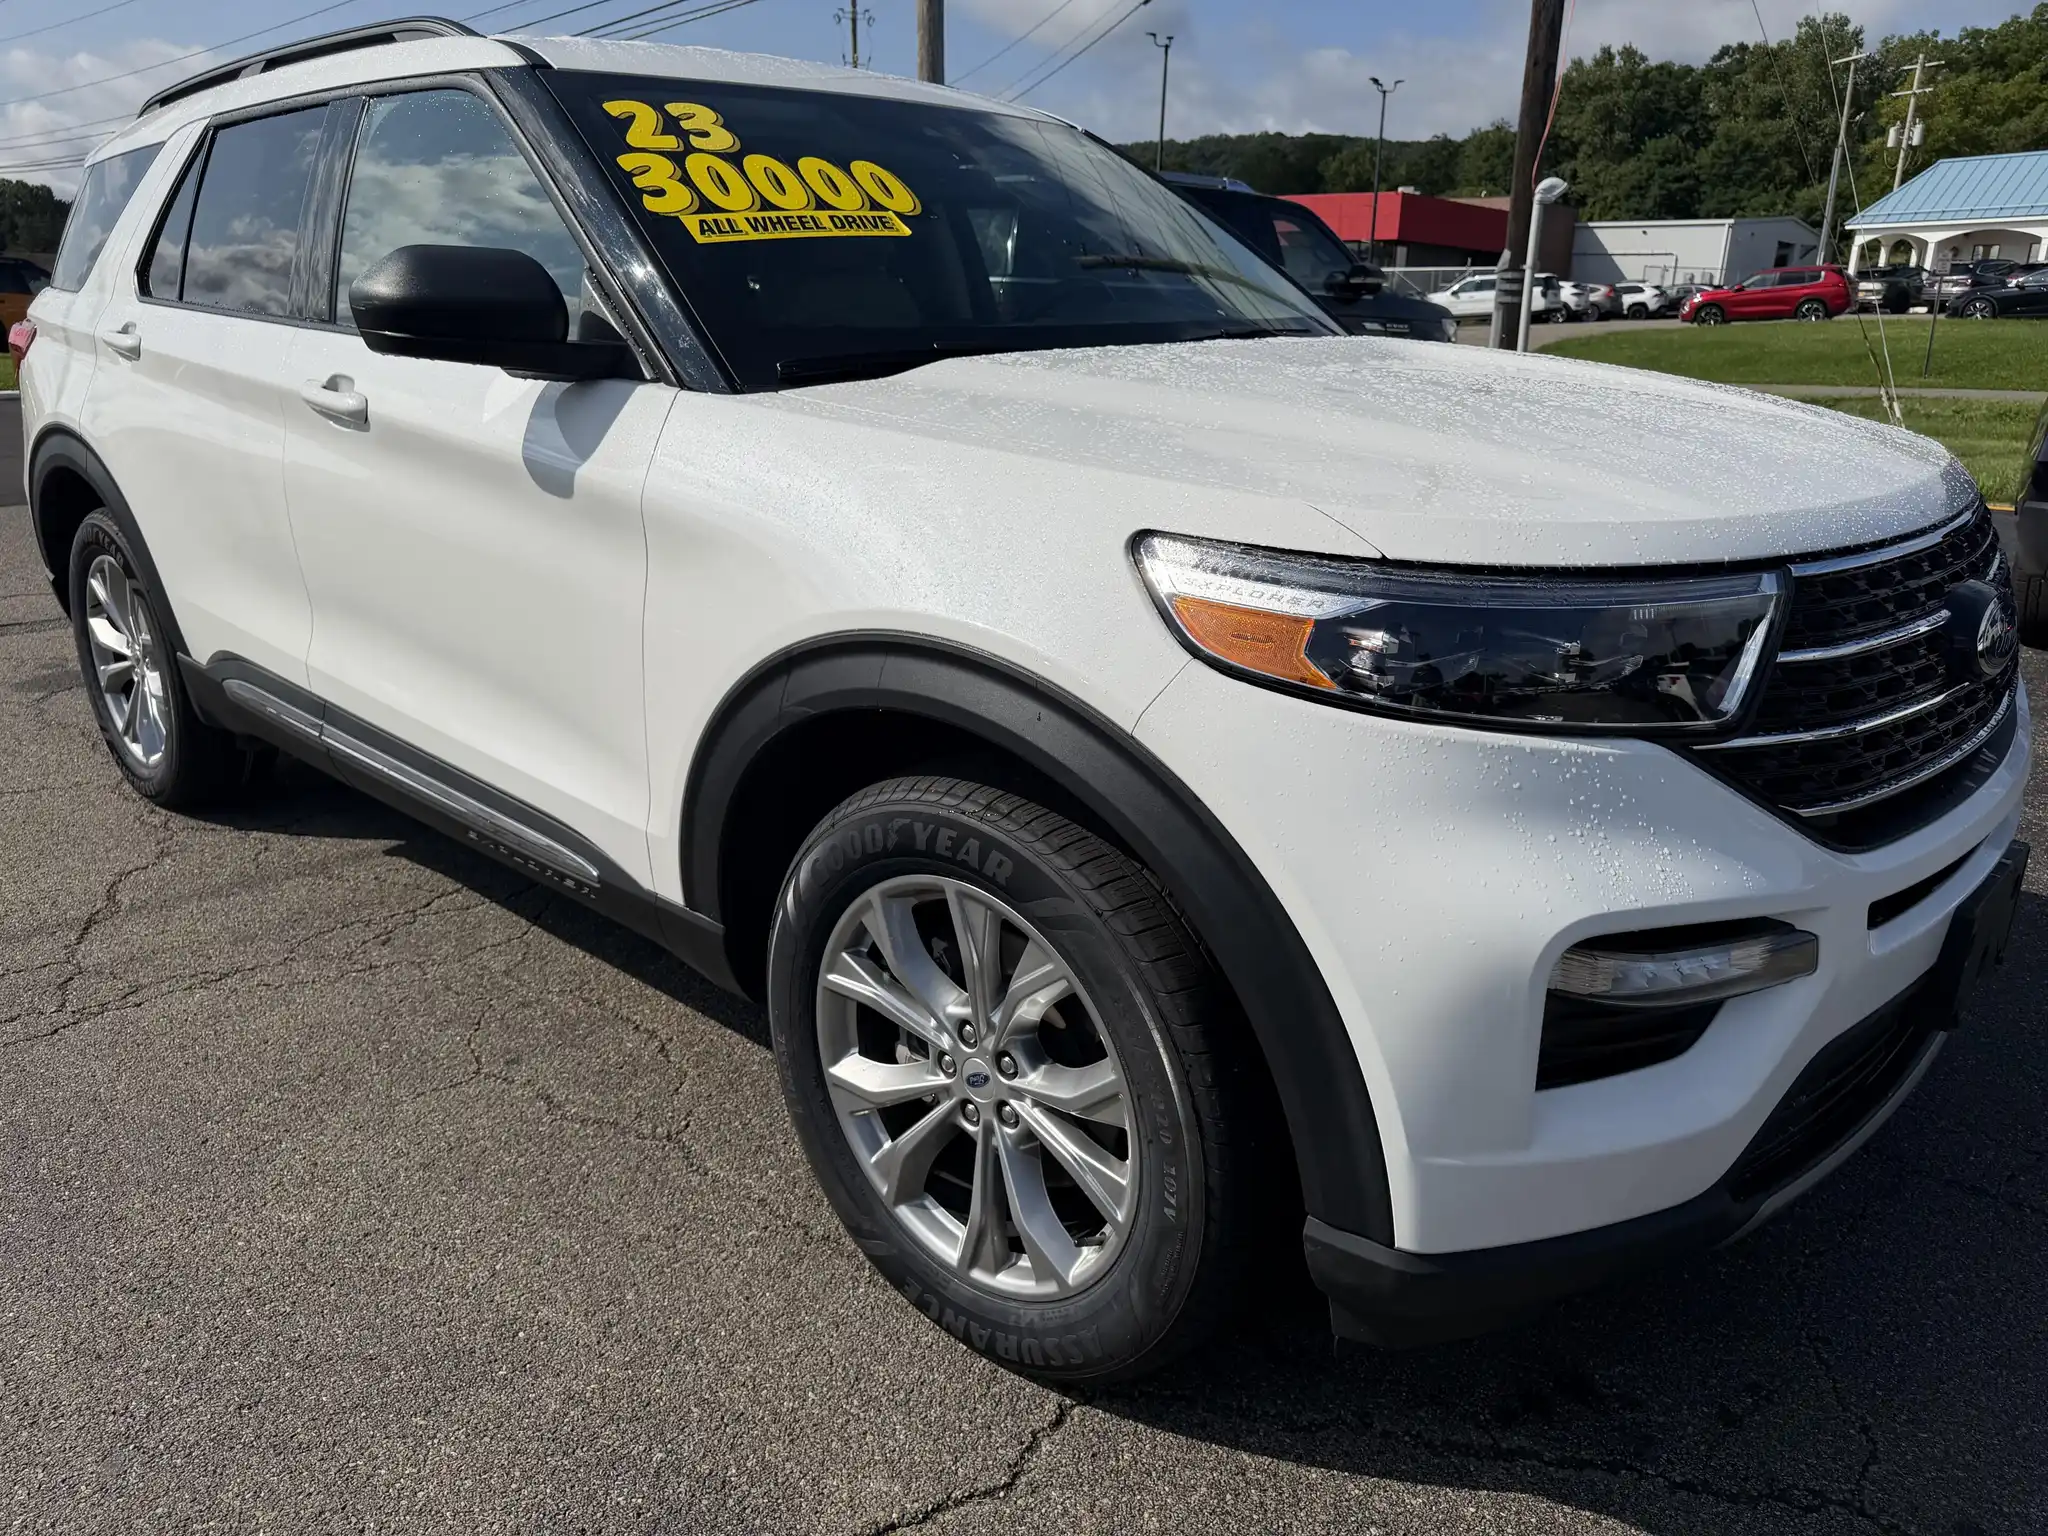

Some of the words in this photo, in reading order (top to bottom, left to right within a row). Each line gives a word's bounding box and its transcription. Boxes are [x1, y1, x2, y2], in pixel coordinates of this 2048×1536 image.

[602, 100, 741, 152] 23
[616, 152, 922, 216] 30000
[698, 217, 746, 238] ALL
[744, 214, 830, 234] WHEEL
[827, 214, 897, 232] DRIVE
